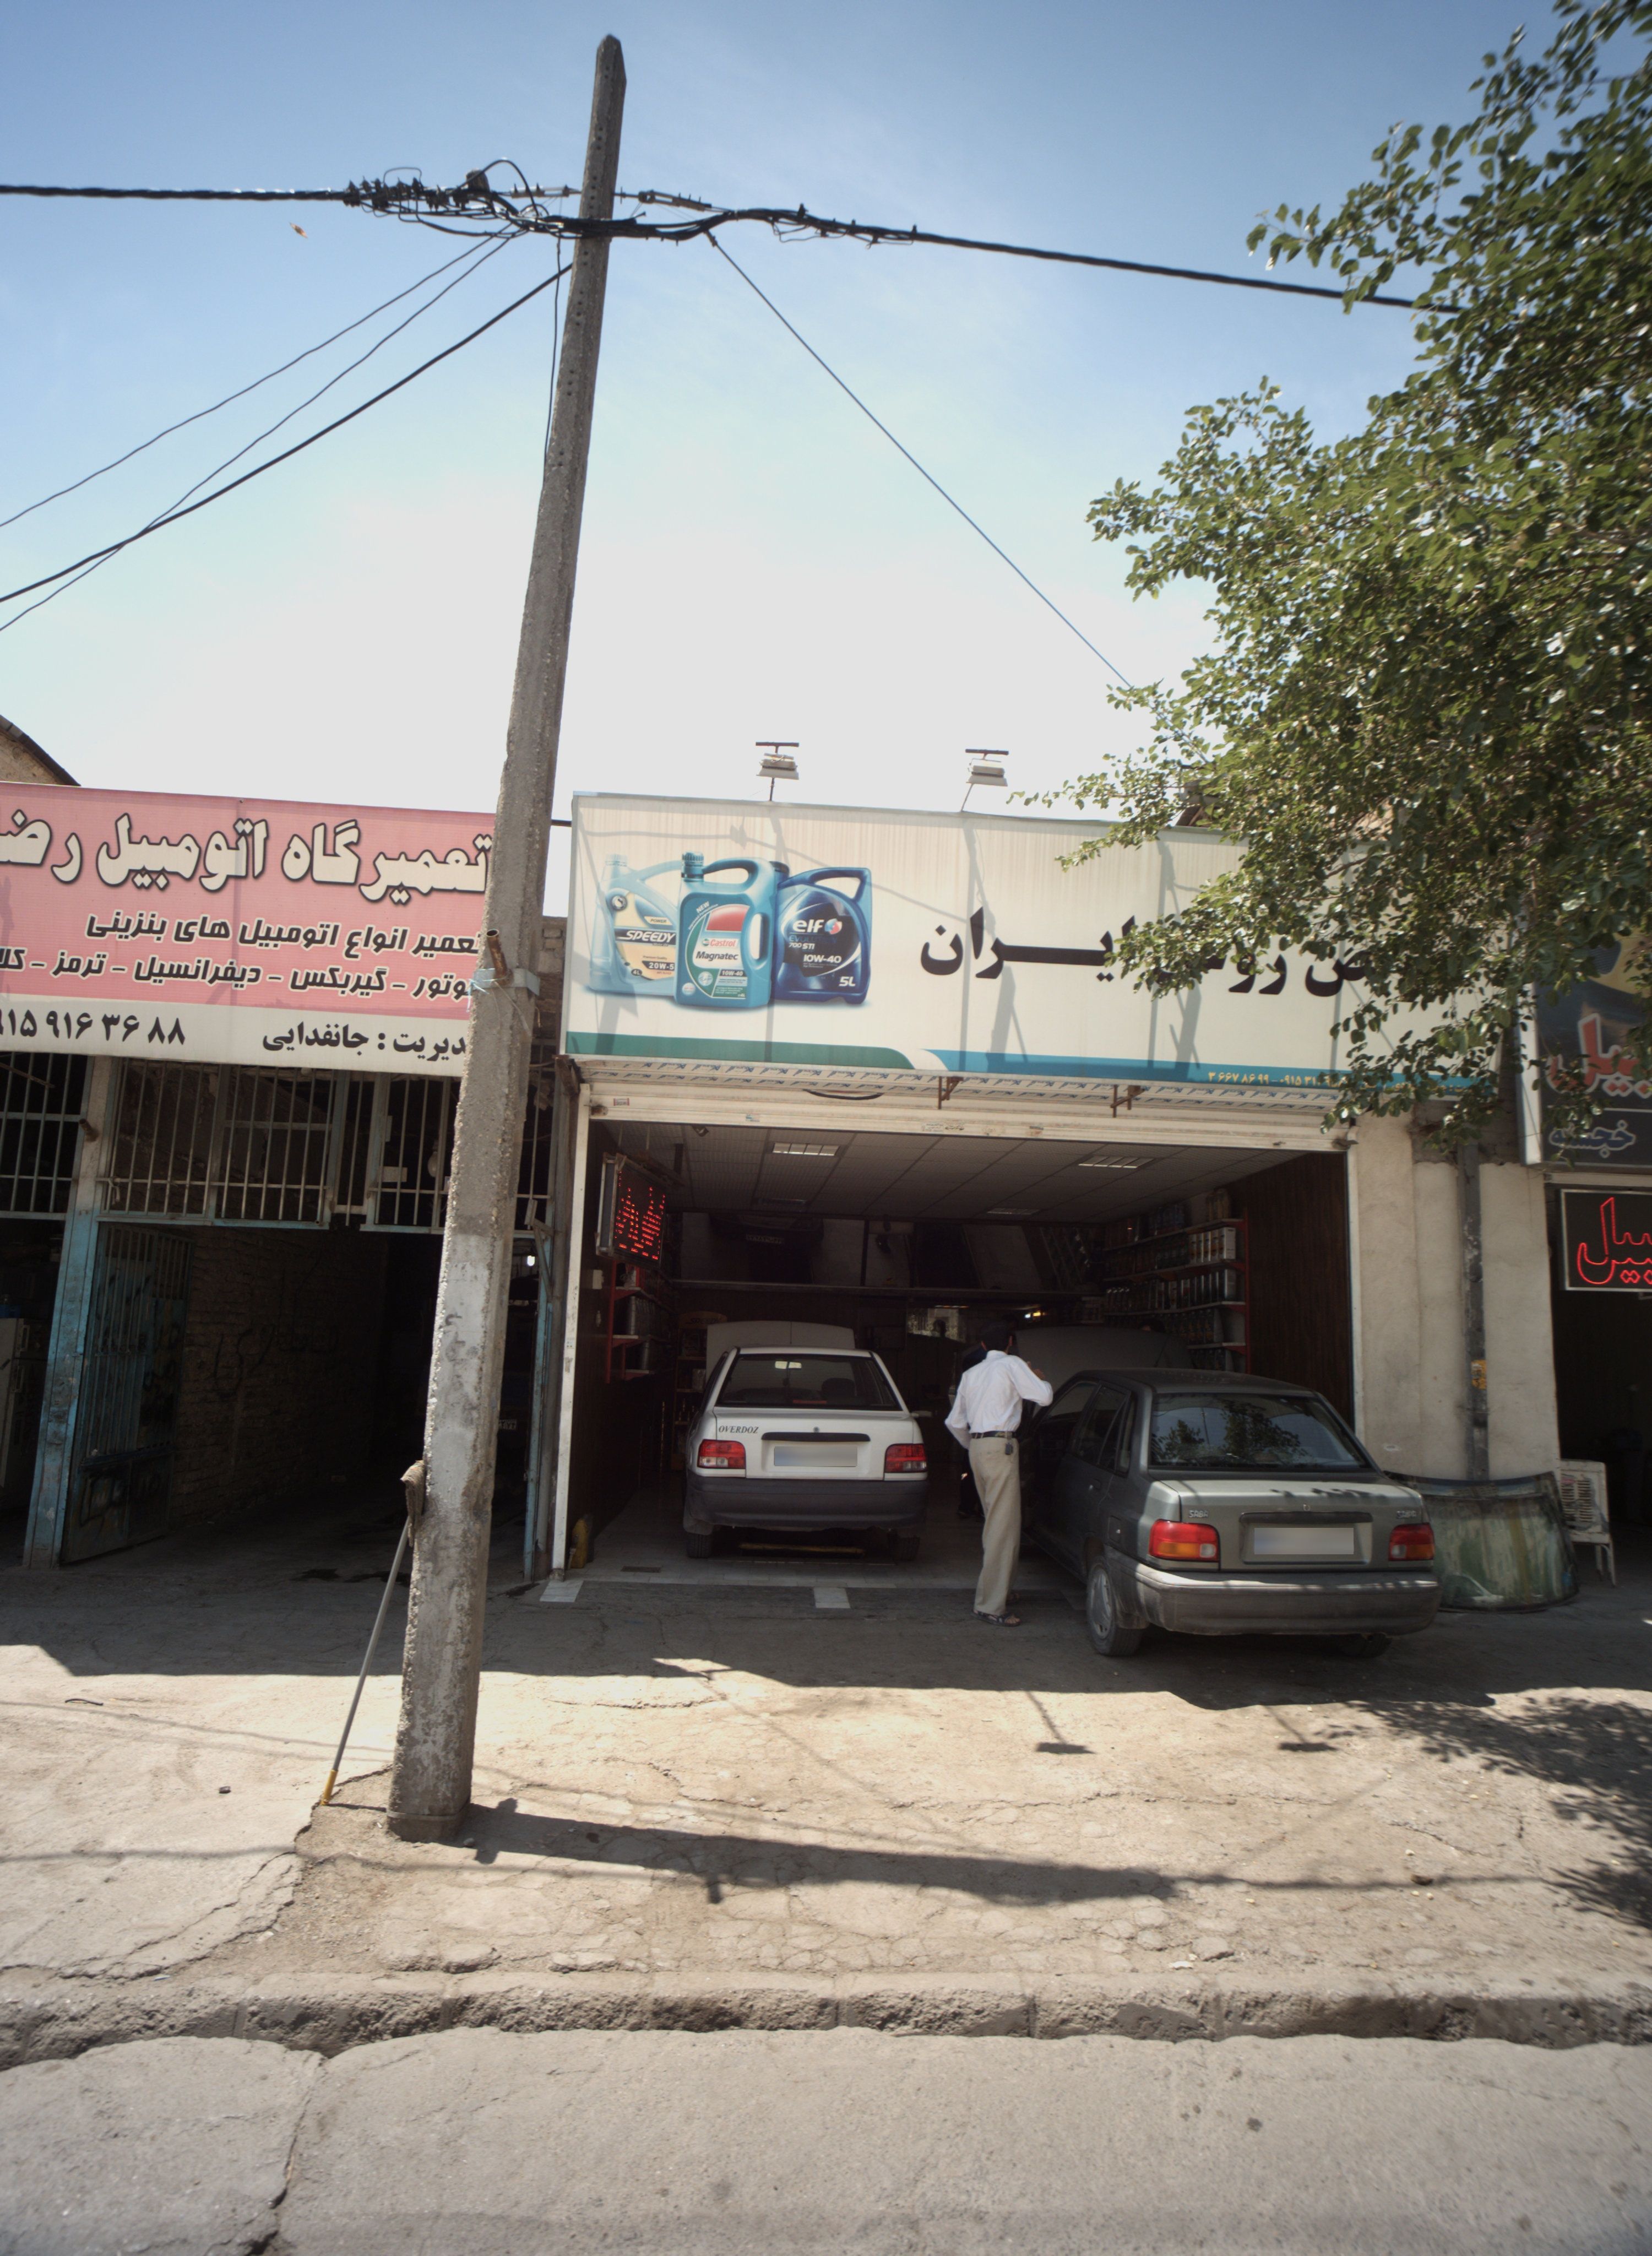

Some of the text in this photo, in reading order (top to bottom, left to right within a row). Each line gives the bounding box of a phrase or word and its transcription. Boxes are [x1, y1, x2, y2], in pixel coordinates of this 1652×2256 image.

[0, 809, 83, 883] رض
[96, 812, 269, 892] اتومبیل
[695, 901, 710, 914] NEW
[86, 911, 481, 959] عمیر انواع اتومبیل های بنزینی
[617, 930, 676, 943] SPEEDY
[792, 919, 825, 933] elf
[695, 951, 739, 962] Magnatec
[710, 939, 737, 947] Castrol
[0, 948, 25, 970] کلا
[52, 952, 107, 977] ترمز
[803, 954, 842, 963] 10W-40
[134, 957, 261, 989] دیفرانسیل
[290, 967, 388, 996] گیربکس
[839, 976, 856, 987] 5L
[412, 974, 470, 1001] وتور
[46, 1010, 93, 1040] ۹۱۶
[101, 1013, 140, 1042] ۳۶
[148, 1016, 186, 1045] ۸۸
[262, 1021, 369, 1056] جانفدایی
[393, 1033, 466, 1062] دیریت
[719, 1425, 759, 1434] OVERDOZ
